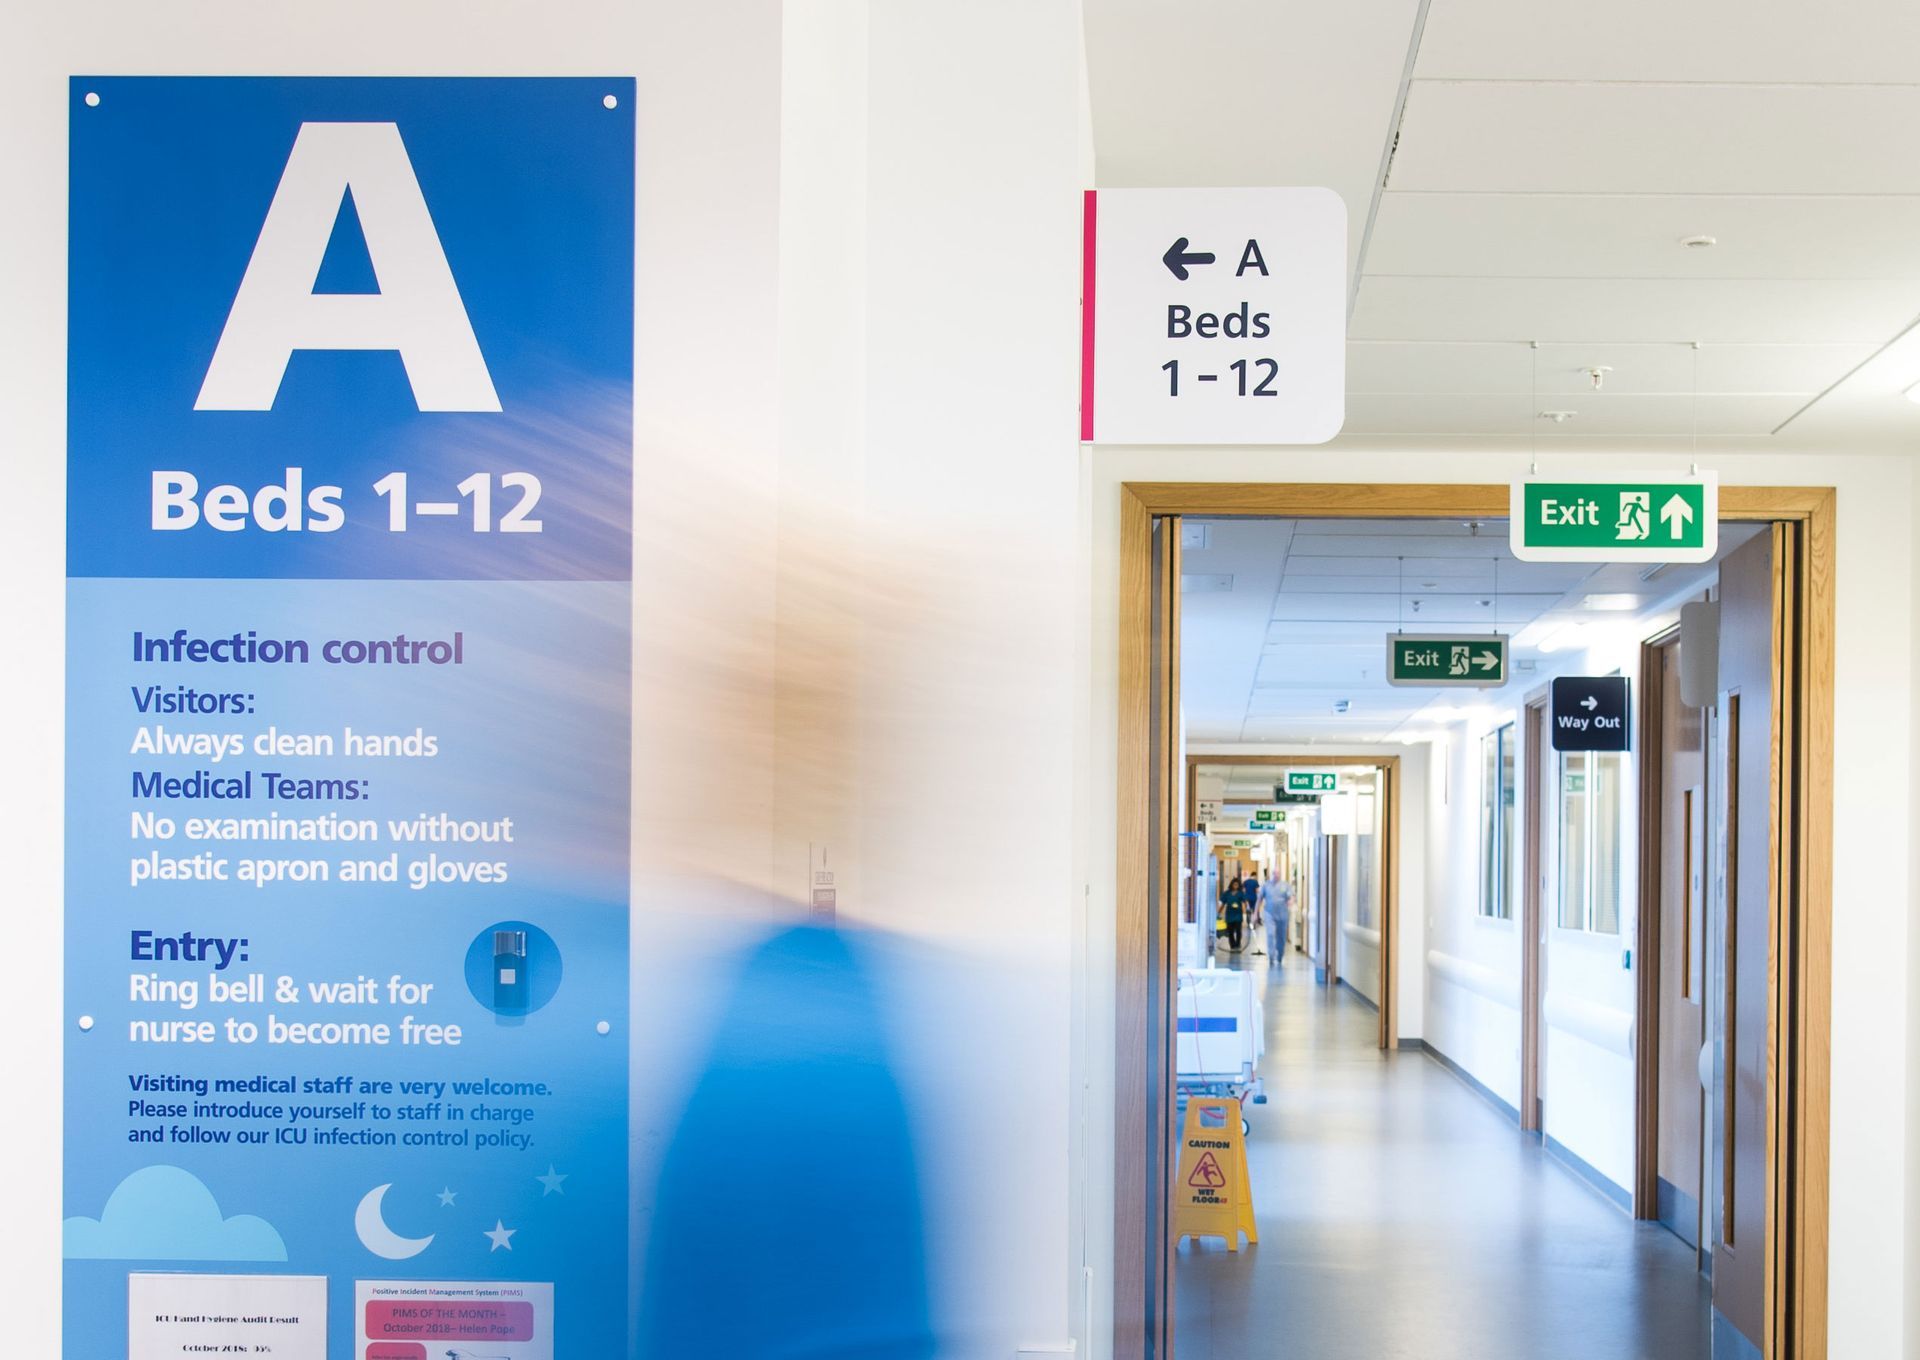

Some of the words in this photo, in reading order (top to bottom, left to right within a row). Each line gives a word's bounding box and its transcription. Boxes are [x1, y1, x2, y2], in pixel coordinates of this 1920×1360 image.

[193, 122, 503, 412] A
[1236, 239, 1269, 276] A
[1168, 302, 1270, 338] Beds
[152, 468, 344, 532] Beds
[1542, 499, 1599, 525] Exit
[134, 630, 308, 663] Infection
[323, 632, 462, 664] control
[1405, 650, 1439, 666] Exit
[132, 686, 254, 713] Visitors:
[1558, 716, 1589, 731] Way
[1595, 716, 1620, 728] Out
[131, 726, 244, 762] Always
[254, 727, 333, 755] clean
[345, 728, 438, 756] hands
[133, 771, 251, 799] Medical
[262, 773, 368, 800] Teams:
[1292, 776, 1309, 785] Exit
[132, 812, 175, 839] No
[185, 812, 377, 840] examination
[388, 813, 513, 842] without
[132, 851, 228, 886] plastic
[238, 859, 329, 888] apron
[340, 853, 397, 881] and
[409, 853, 507, 889] gloves
[132, 931, 248, 970] Entry:
[131, 973, 198, 1009] Ring
[210, 973, 263, 1002] bell
[276, 976, 299, 1002] &
[309, 976, 378, 1003] wait
[387, 975, 433, 1004] for
[131, 1021, 215, 1042] nurse
[224, 1018, 258, 1043] to
[269, 1015, 390, 1044] become
[400, 1016, 462, 1045] free
[129, 1075, 208, 1096] Visiting
[216, 1076, 295, 1093] medical
[304, 1077, 353, 1093] staff
[360, 1082, 392, 1094] are
[400, 1082, 445, 1099] very
[453, 1077, 552, 1096] welcome.
[130, 1100, 187, 1117] Please
[195, 1101, 283, 1118] introduce
[289, 1102, 365, 1123] yourself
[371, 1105, 391, 1119] to
[398, 1103, 441, 1120] staff
[448, 1104, 463, 1120] in
[471, 1104, 533, 1125] charge
[129, 1126, 163, 1142] and
[170, 1126, 230, 1143] follow
[237, 1131, 269, 1143] our
[276, 1128, 306, 1144] ICU
[314, 1127, 395, 1145] infection
[403, 1129, 468, 1145] control
[476, 1130, 534, 1151] policy.
[1189, 1140, 1229, 1148] CAUTION
[475, 1289, 499, 1297] System
[393, 1309, 417, 1318] PIMS
[420, 1309, 433, 1318] OF
[437, 1310, 454, 1318] THE
[458, 1310, 497, 1319] MONTH
[384, 1324, 423, 1333] October
[459, 1325, 487, 1334] Helen
[491, 1325, 515, 1335] Pope
